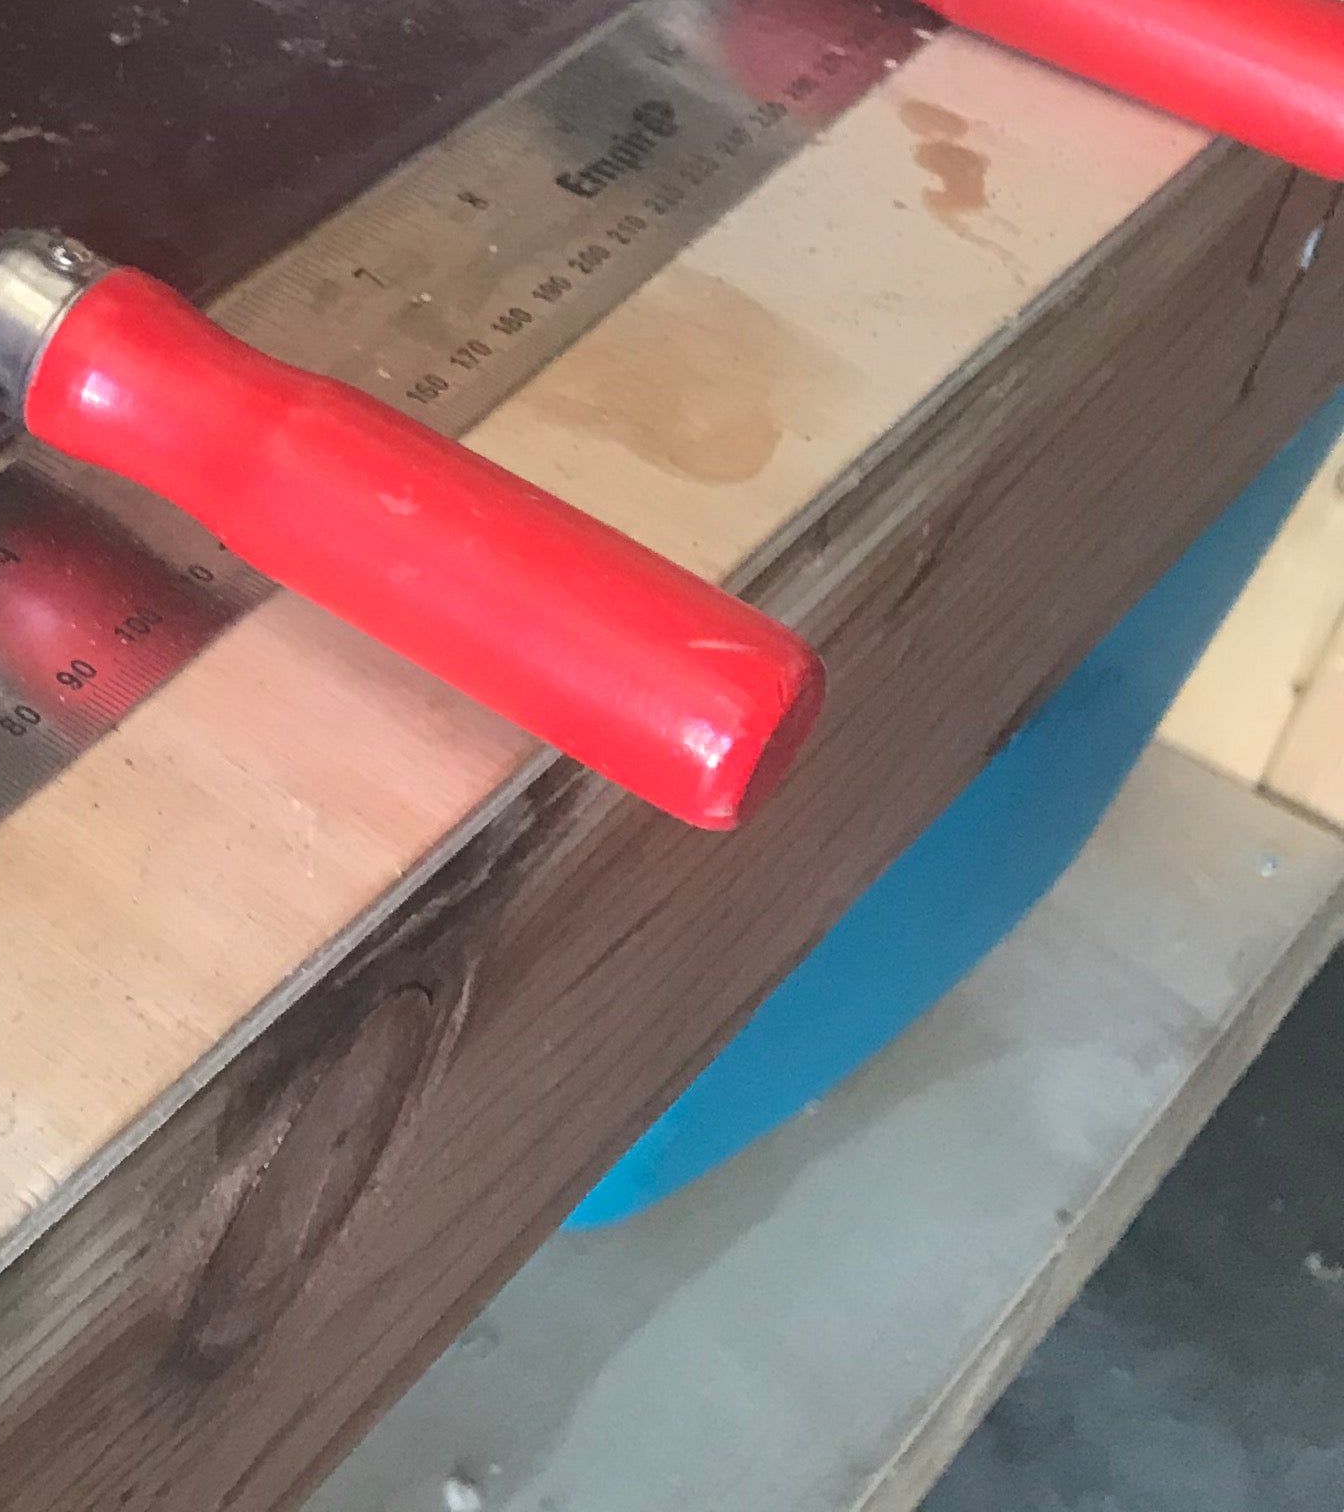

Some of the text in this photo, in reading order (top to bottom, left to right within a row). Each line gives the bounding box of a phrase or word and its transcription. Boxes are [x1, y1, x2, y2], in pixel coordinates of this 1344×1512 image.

[351, 267, 385, 289] 7
[56, 660, 97, 690] 90
[114, 607, 164, 642] 100
[449, 339, 493, 370] 170
